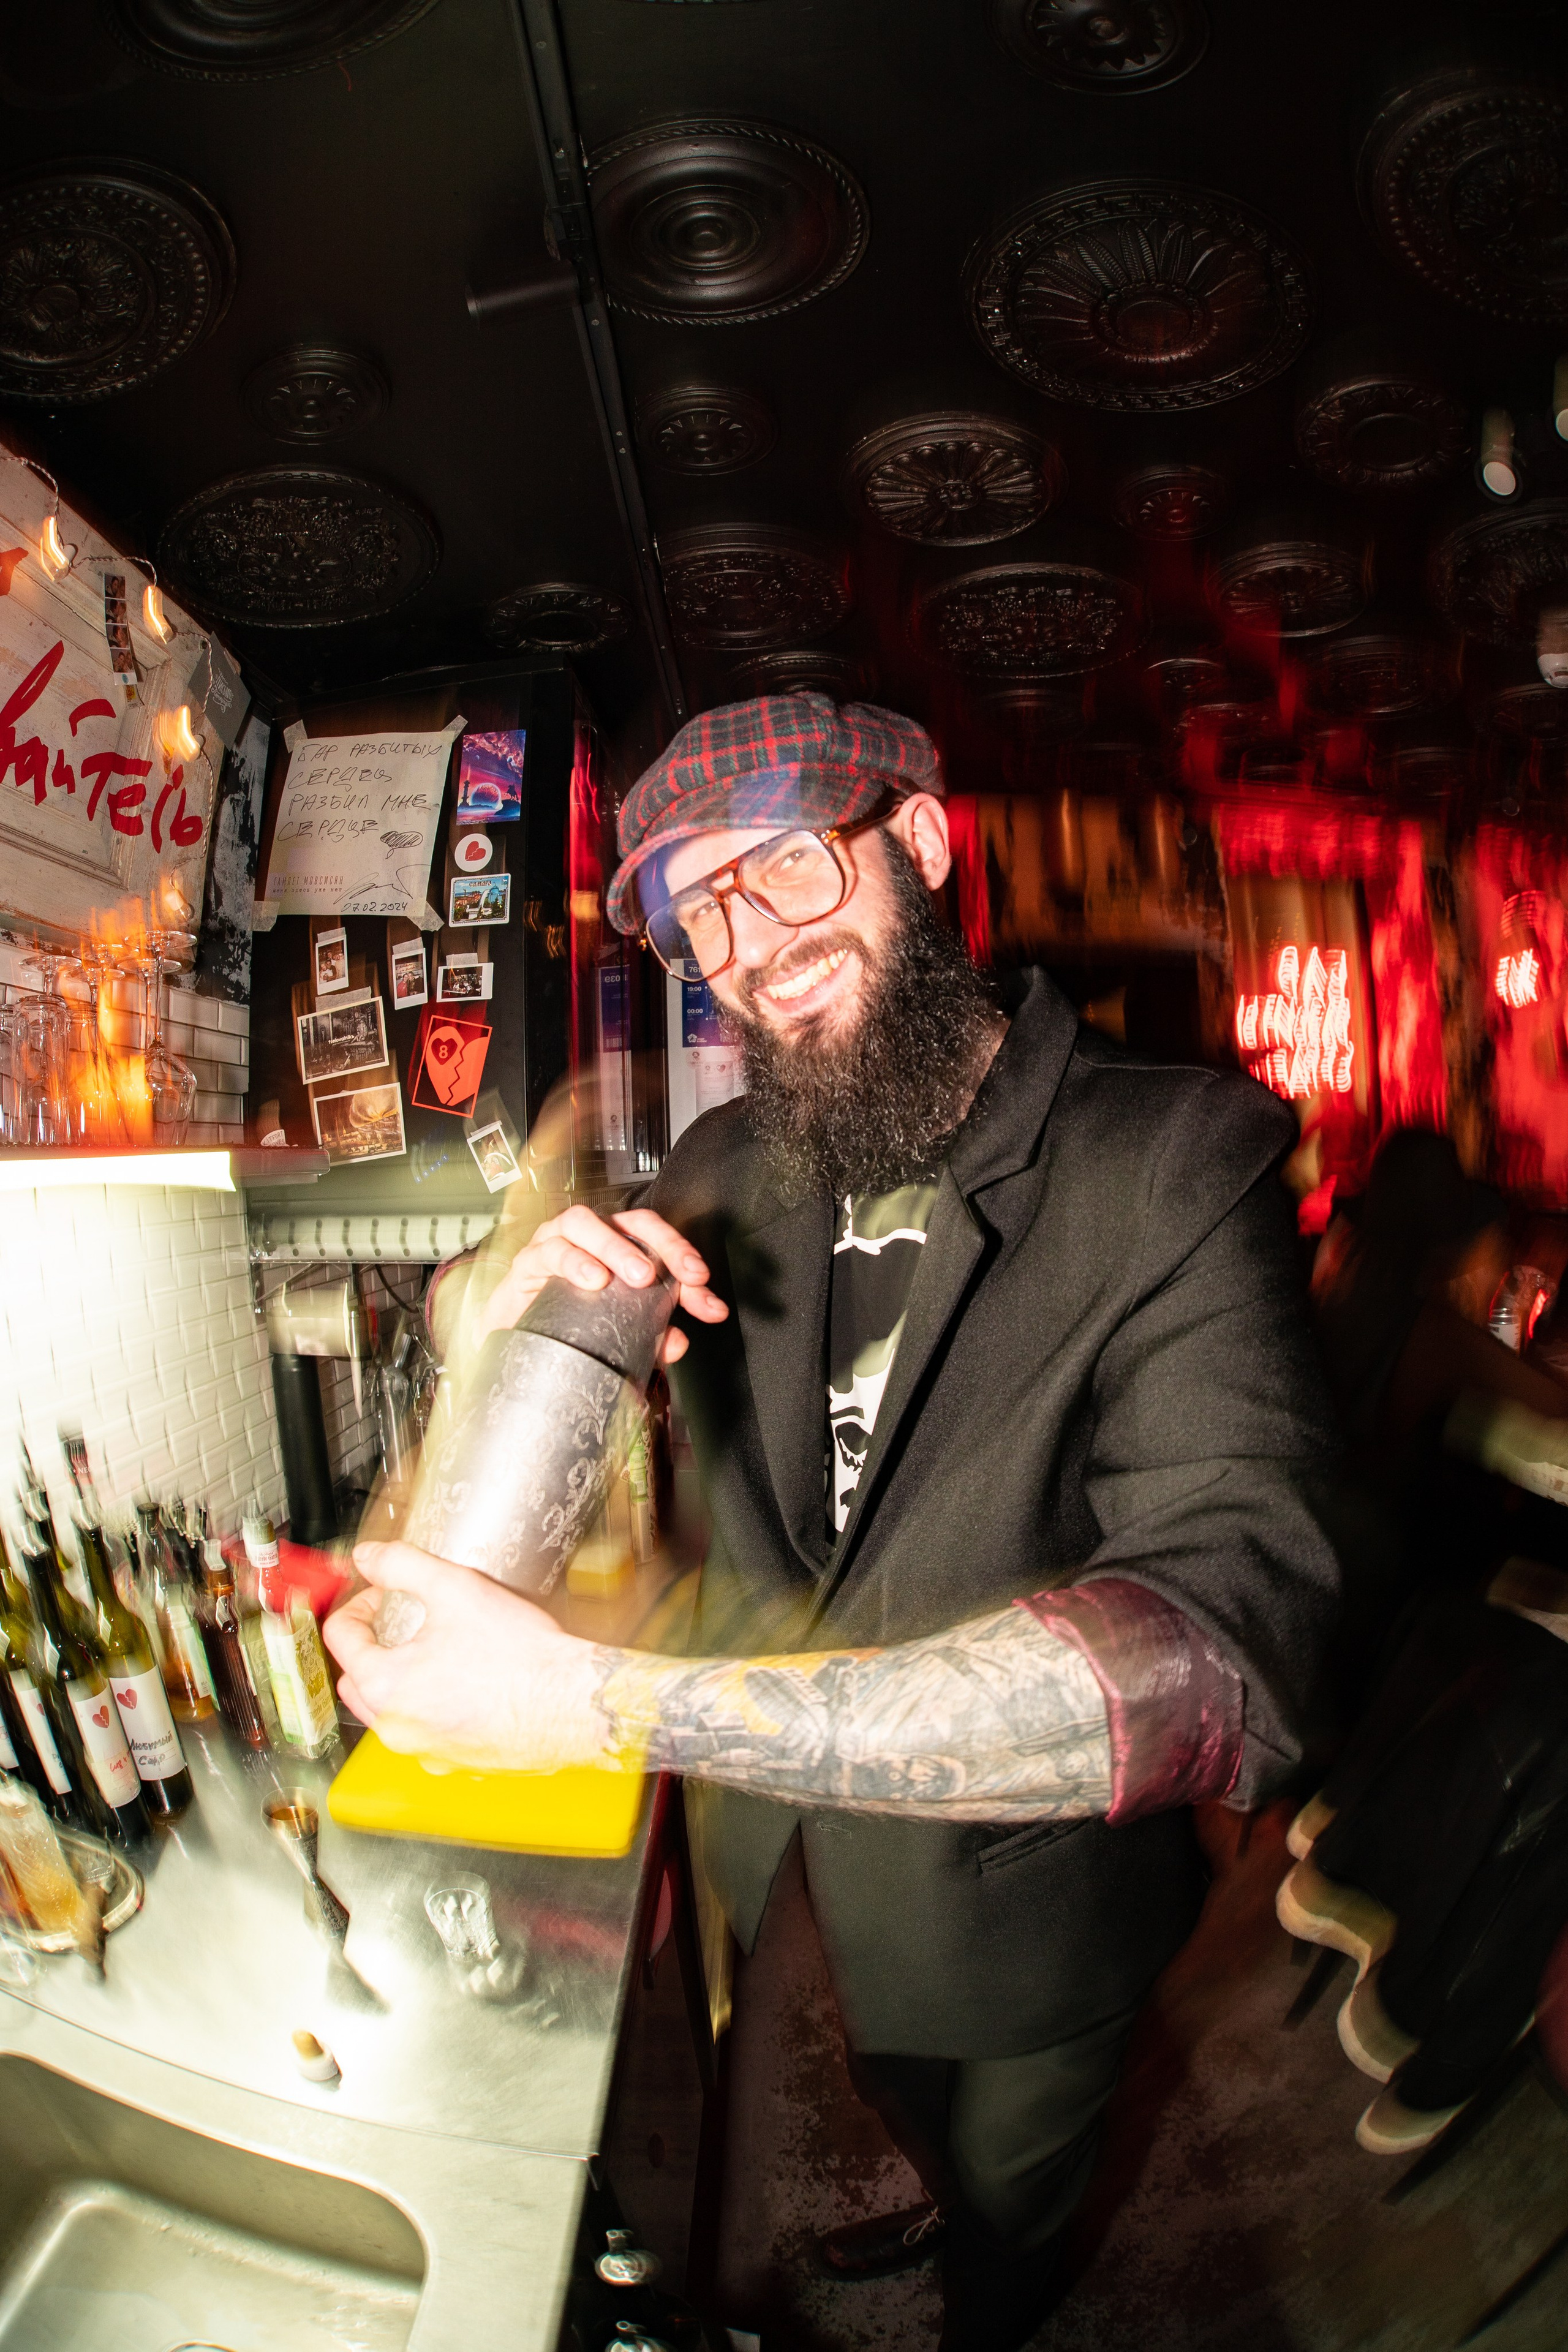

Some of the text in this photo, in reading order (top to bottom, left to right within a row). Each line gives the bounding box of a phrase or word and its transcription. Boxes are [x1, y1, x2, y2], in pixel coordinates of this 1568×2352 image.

[297, 742, 442, 763] БАР РАЗБИТЫХ
[288, 766, 392, 791] СЕРДЕЦ
[288, 793, 432, 816] РАЗБИЛ МНЕ
[277, 819, 380, 843] СЕРДЦЕ
[273, 875, 344, 886] ГАМЛЕТ МОВСИСЯН
[439, 1045, 448, 1059] 8
[262, 1131, 284, 1146] KITFORT
